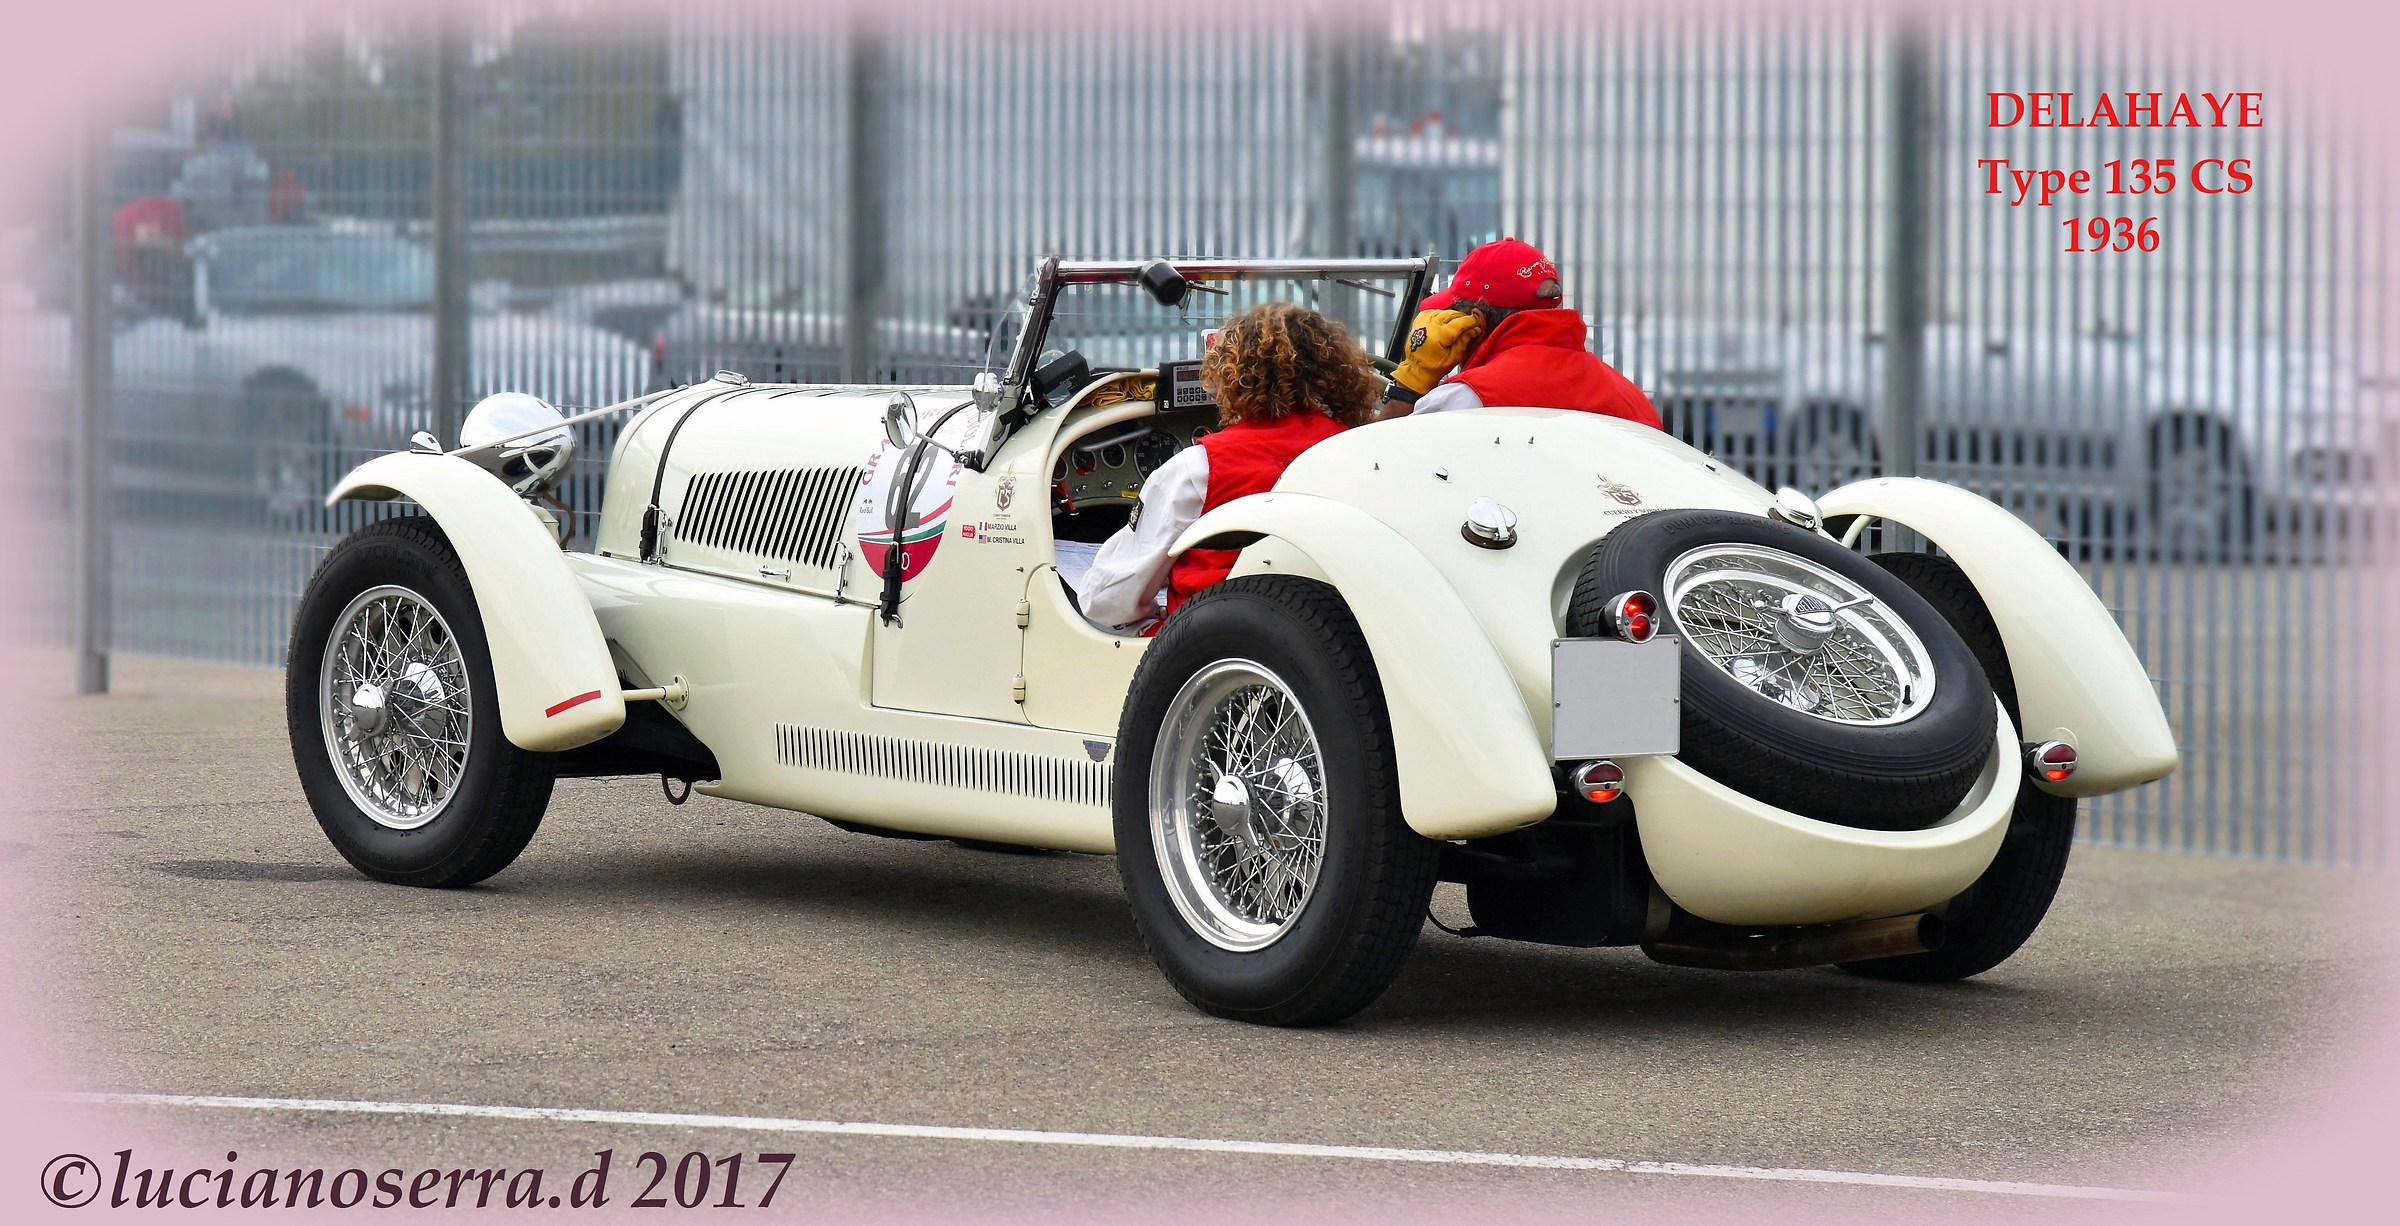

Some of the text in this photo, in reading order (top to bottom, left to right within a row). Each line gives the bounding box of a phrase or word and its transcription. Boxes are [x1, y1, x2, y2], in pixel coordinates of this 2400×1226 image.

[987, 523, 1004, 531] MARZIO
[1662, 515, 1721, 535] DUNLOP
[992, 536, 1012, 544] CRISTINA
[1012, 537, 1025, 545] VILLA
